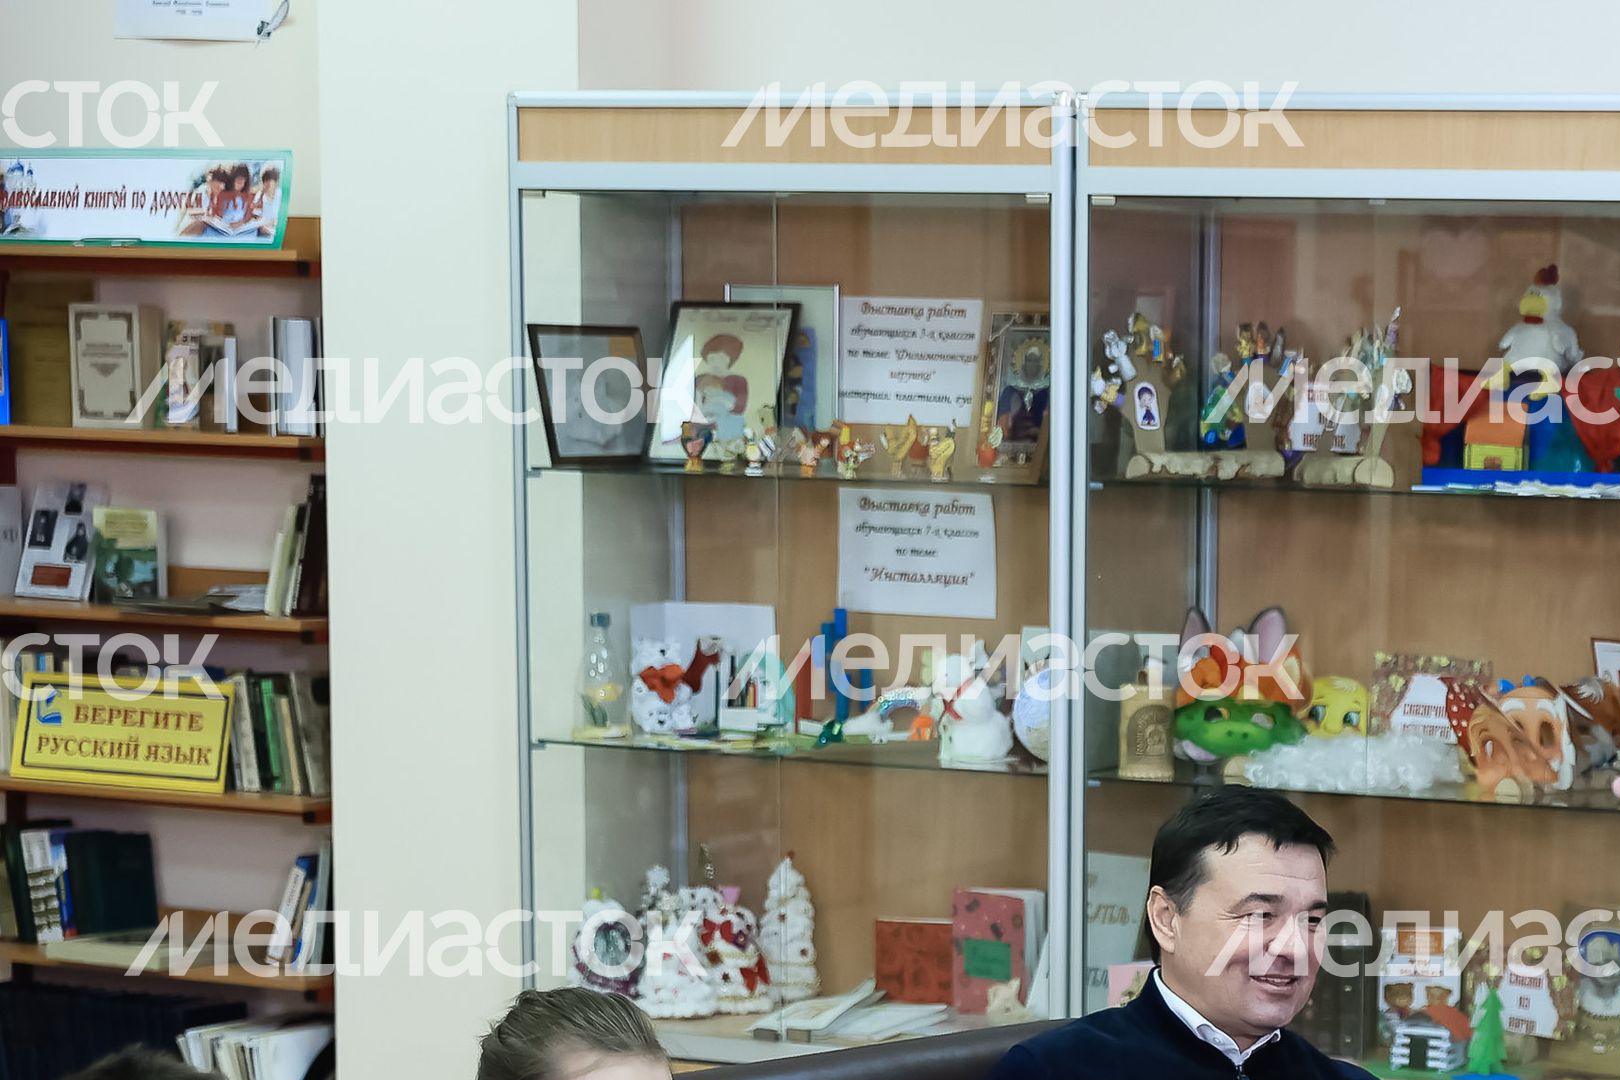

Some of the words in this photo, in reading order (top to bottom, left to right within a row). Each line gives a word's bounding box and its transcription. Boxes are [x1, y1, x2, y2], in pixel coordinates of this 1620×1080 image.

[84, 185, 127, 210] книгой
[131, 192, 147, 209] по
[150, 191, 203, 217] дорогам
[927, 303, 967, 323] работ
[859, 496, 930, 517] Выставка
[933, 499, 976, 519] работ
[73, 703, 204, 732] БЕРЕГИТЕ
[37, 735, 140, 760] РУССКИЙ
[145, 742, 212, 766] ЯЗЫК
